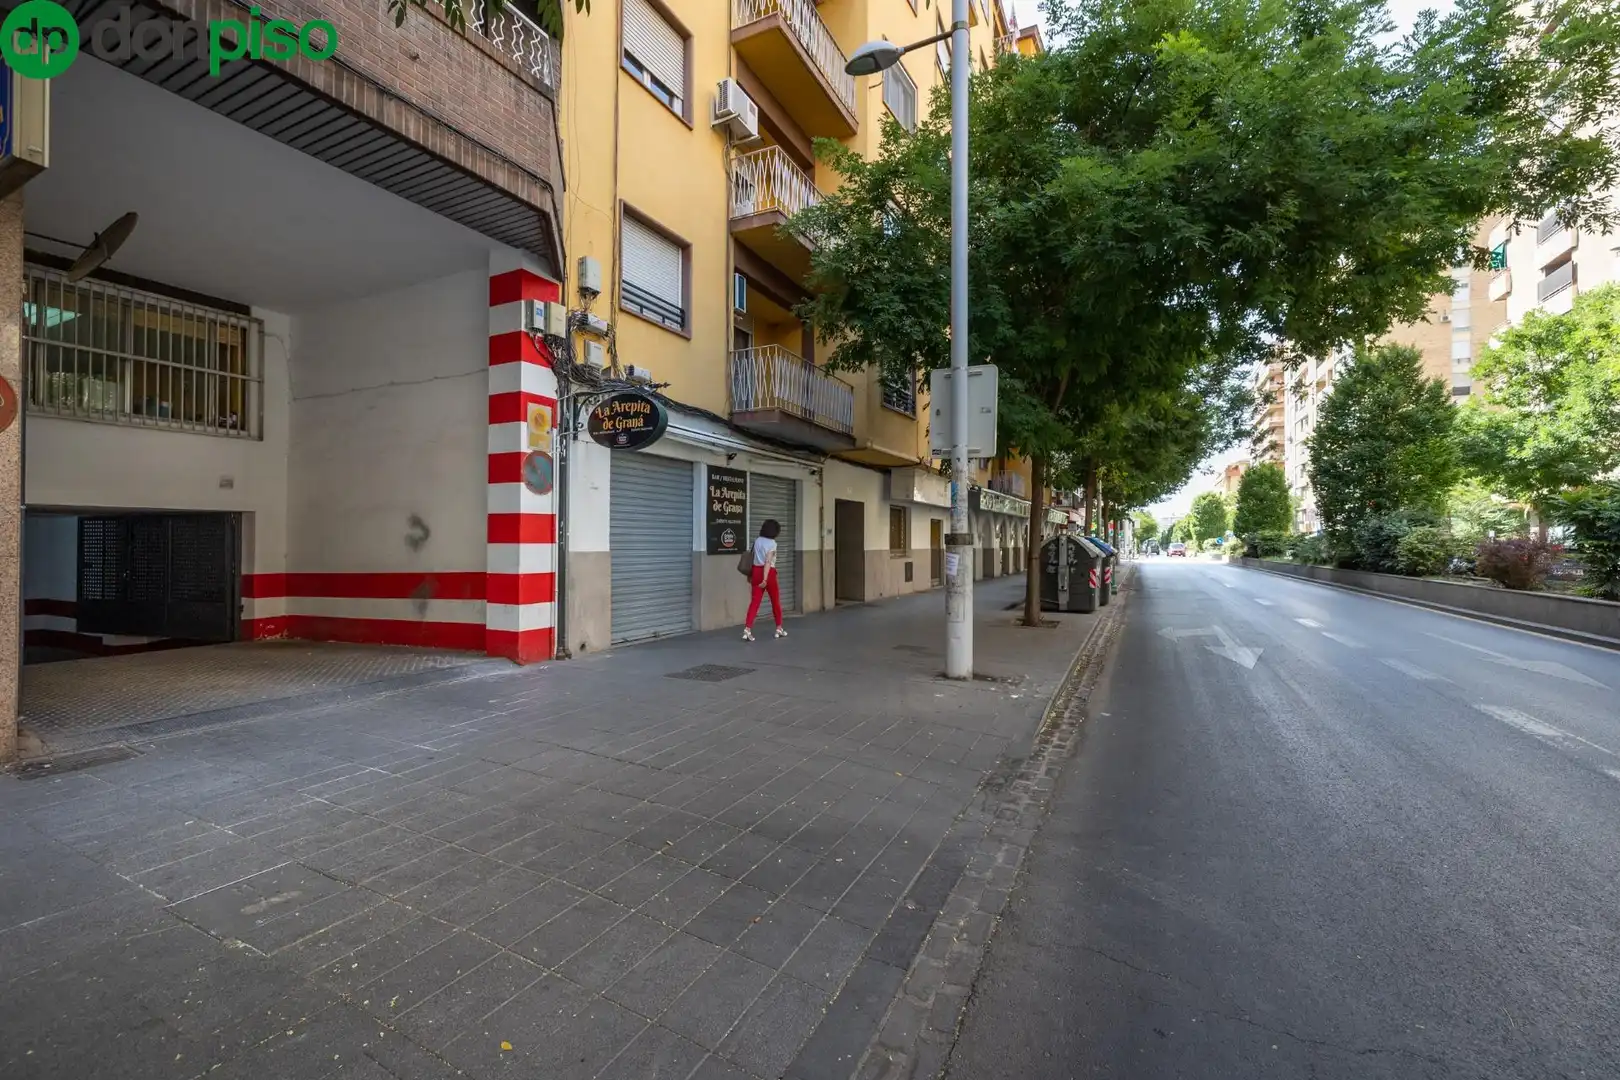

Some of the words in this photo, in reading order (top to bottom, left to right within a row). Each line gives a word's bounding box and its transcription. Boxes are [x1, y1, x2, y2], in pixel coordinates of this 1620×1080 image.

[596, 406, 610, 419] La
[612, 400, 650, 415] Arepita
[603, 418, 613, 430] de
[615, 414, 644, 432] Graná
[709, 485, 721, 497] La
[720, 486, 746, 502] Arepita
[712, 499, 722, 512] de
